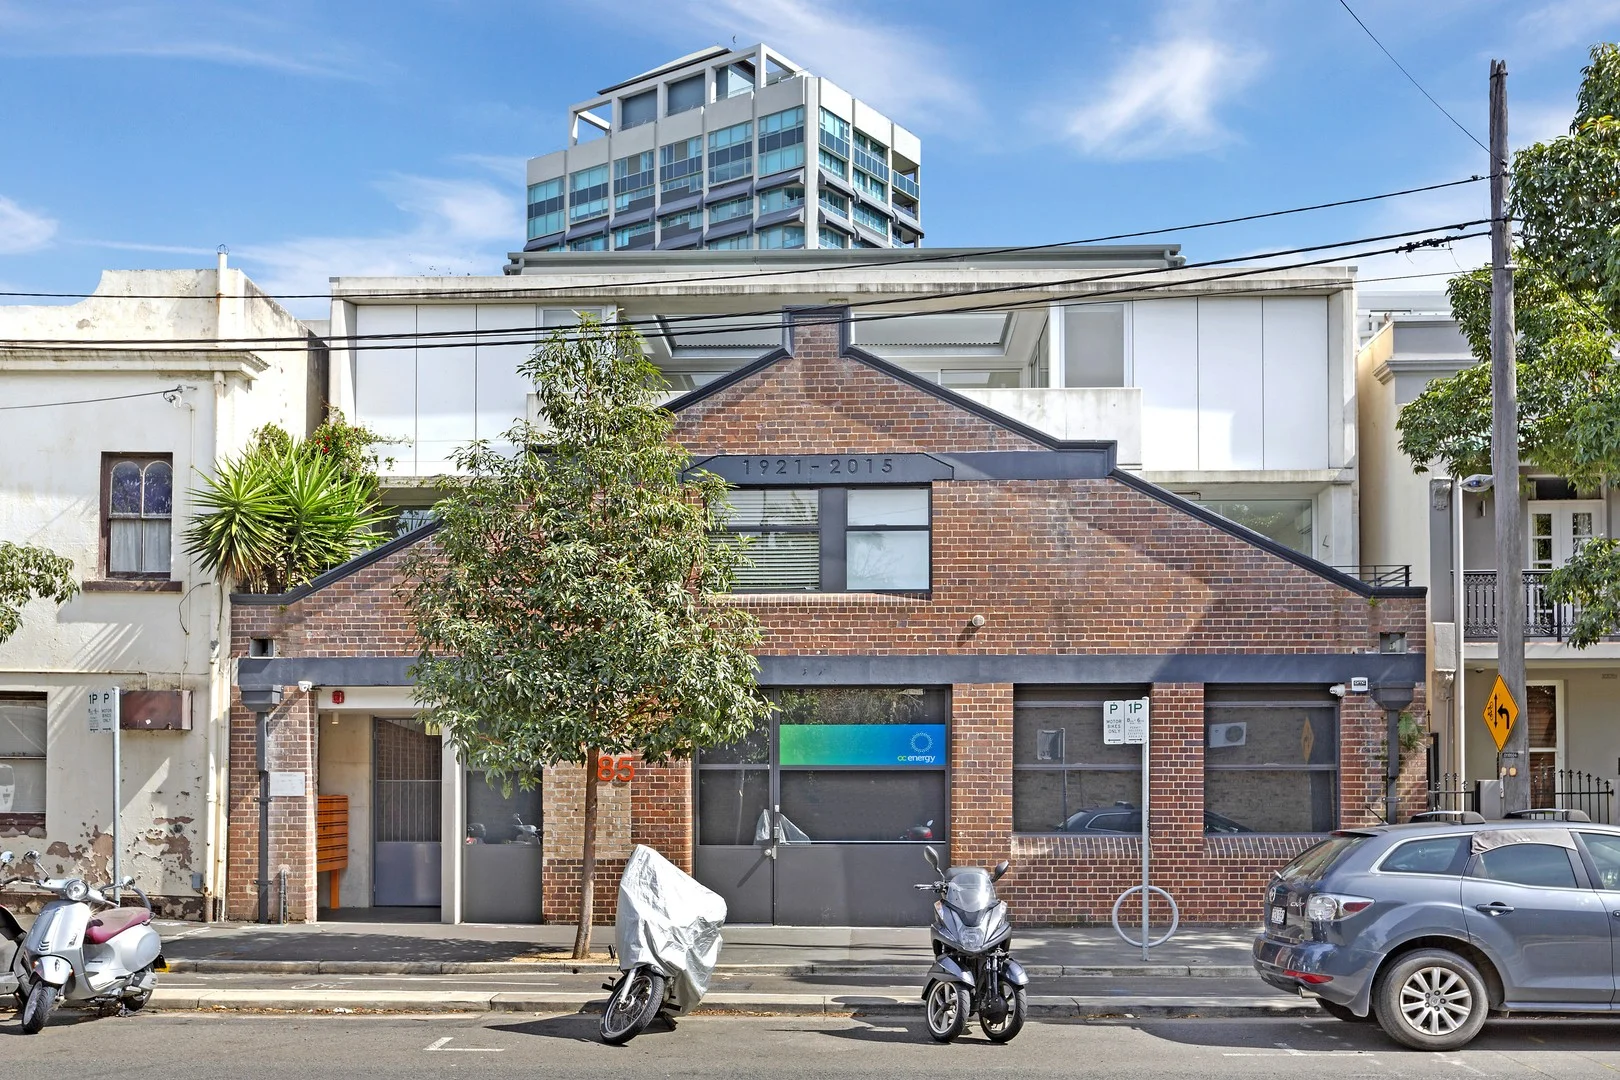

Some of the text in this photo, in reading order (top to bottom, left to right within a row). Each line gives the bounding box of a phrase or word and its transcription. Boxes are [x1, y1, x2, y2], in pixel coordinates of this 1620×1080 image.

[89, 694, 98, 704] 1P
[103, 693, 110, 703] P
[1109, 703, 1119, 714] P
[1128, 703, 1143, 714] 1P
[907, 755, 936, 764] energy
[597, 756, 635, 782] 85
